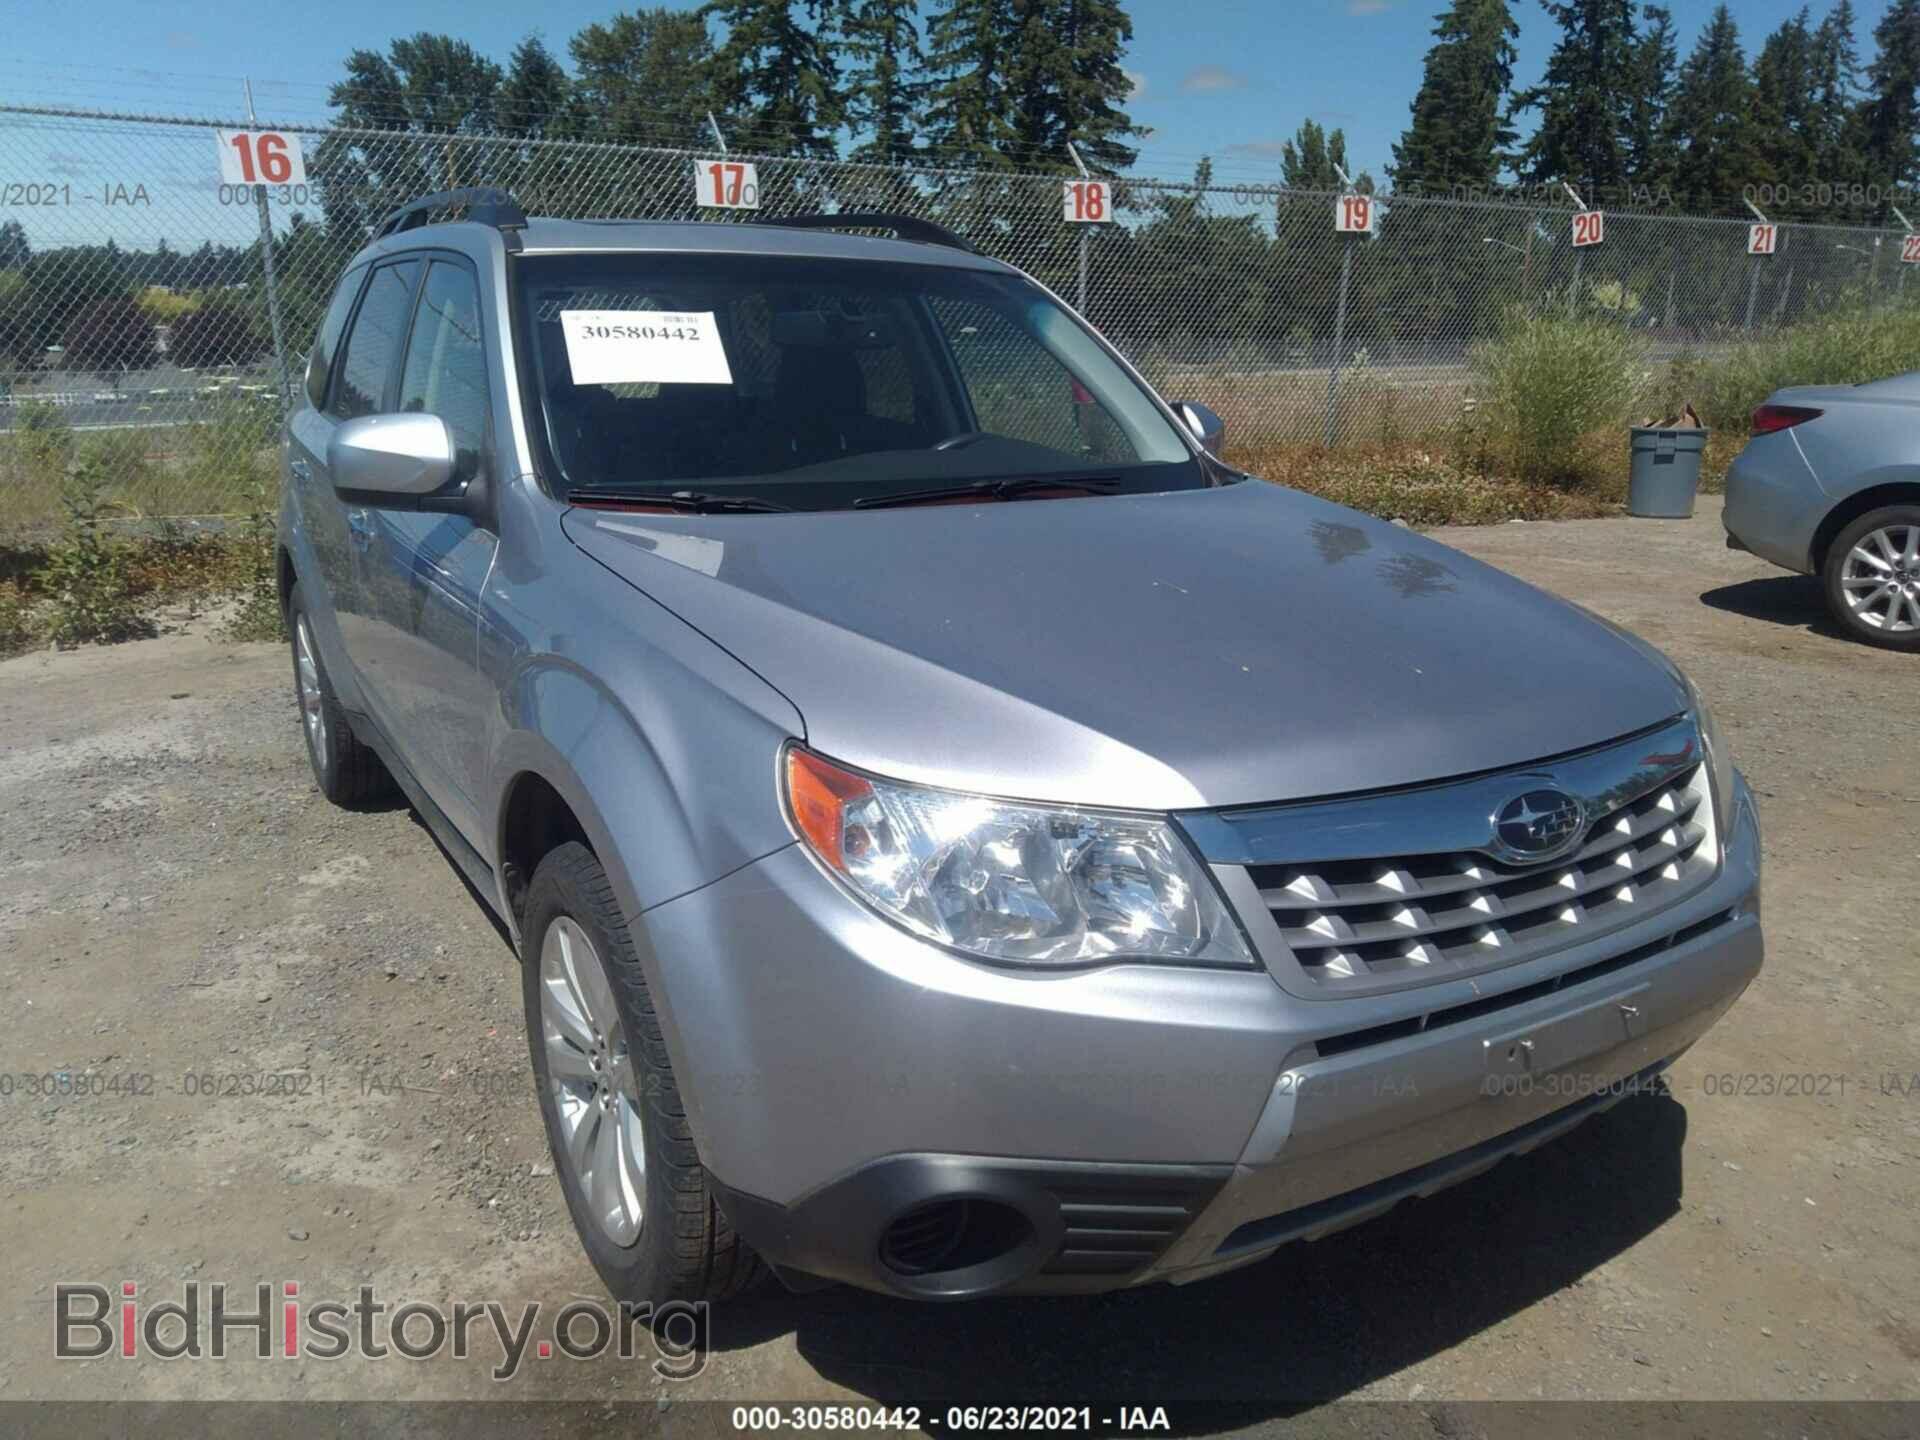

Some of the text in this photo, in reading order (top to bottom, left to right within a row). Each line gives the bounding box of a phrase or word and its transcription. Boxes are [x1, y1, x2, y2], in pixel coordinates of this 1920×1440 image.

[231, 133, 292, 183] 16
[708, 163, 745, 205] 17
[1072, 183, 1104, 220] 18
[1343, 197, 1369, 230] 19
[1575, 212, 1601, 244] 20
[1752, 226, 1773, 252] 21
[581, 325, 701, 341] 30580442
